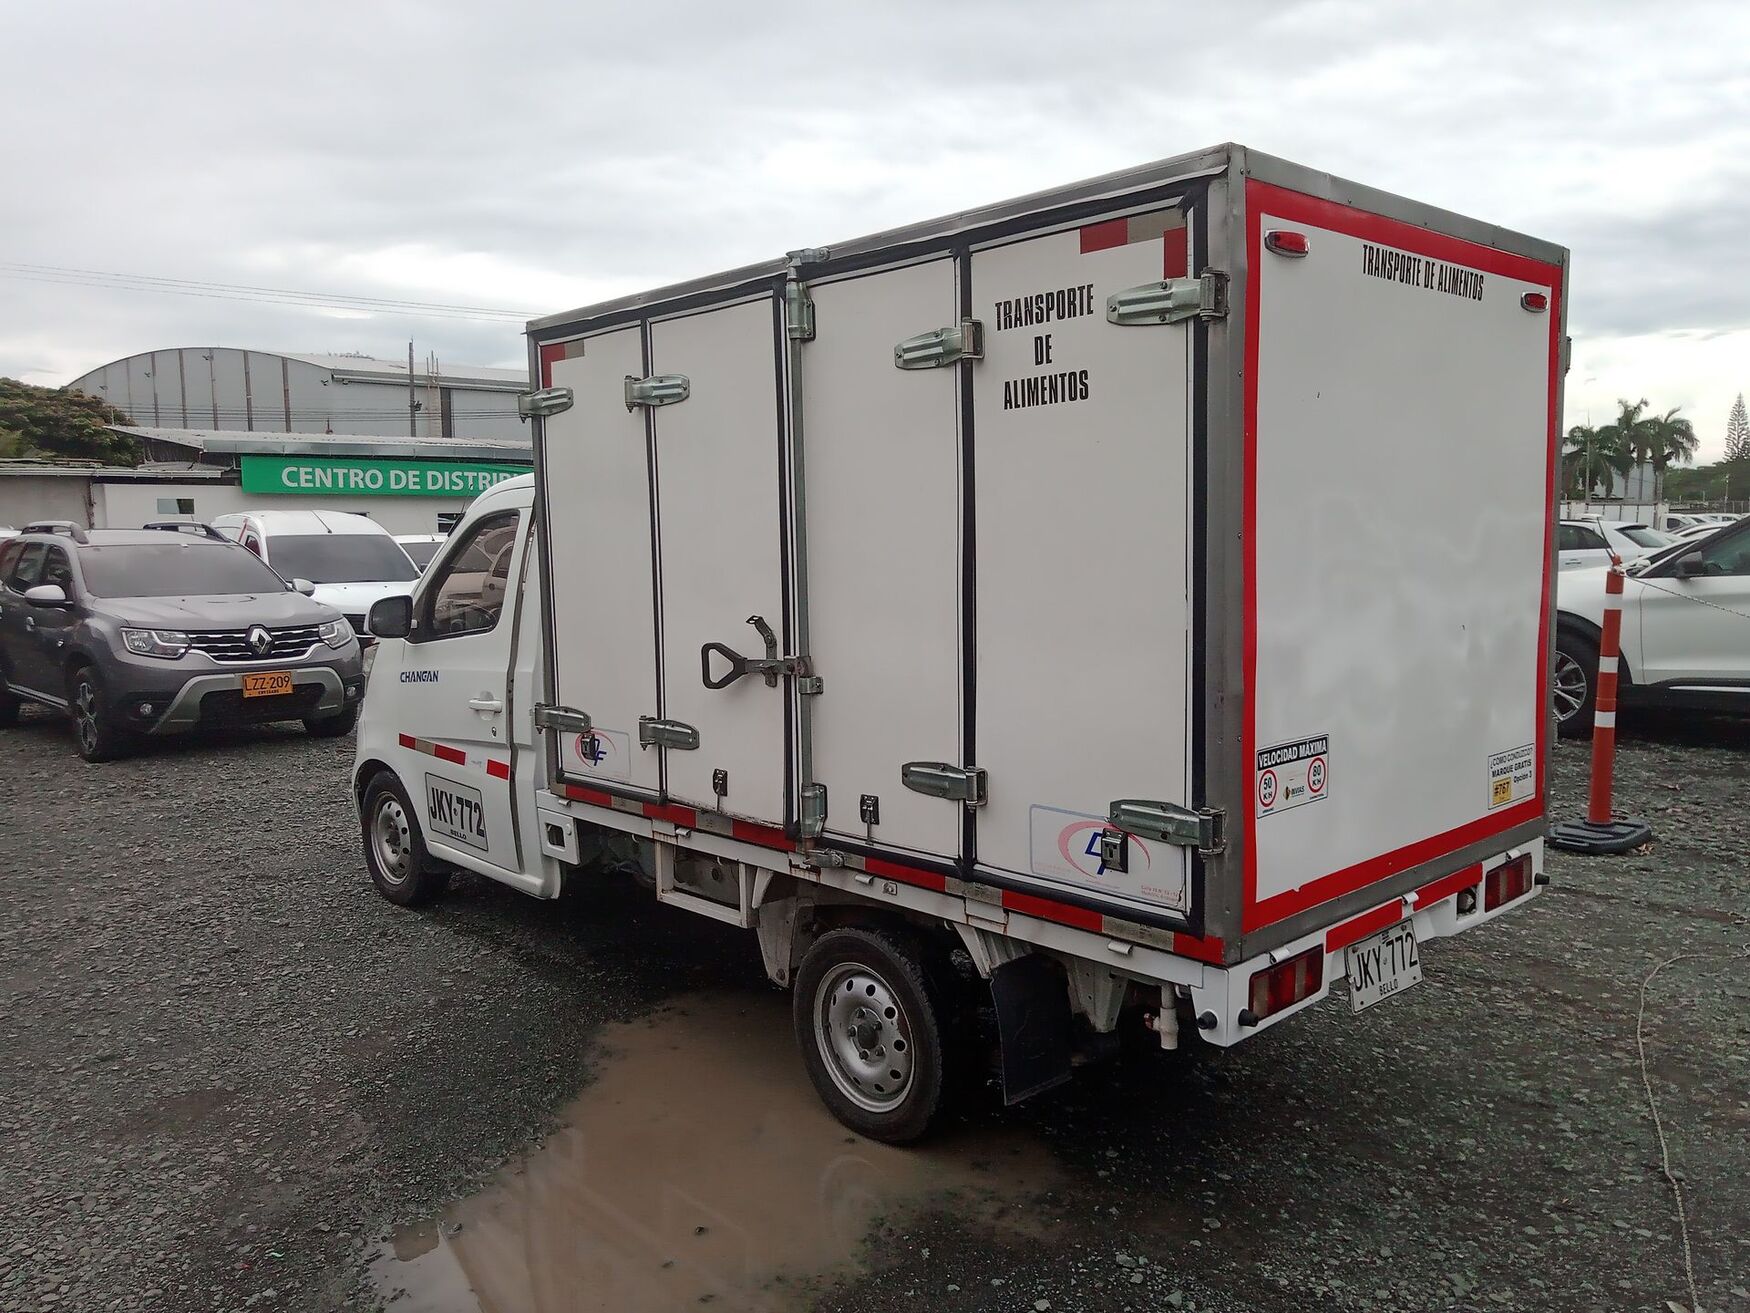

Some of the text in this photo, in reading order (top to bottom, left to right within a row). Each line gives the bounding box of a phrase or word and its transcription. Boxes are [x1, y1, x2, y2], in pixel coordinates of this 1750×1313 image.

[1363, 244, 1484, 301] TRANSPORTE DE ALIMENTOS
[995, 283, 1094, 331] TRANSPORTE
[1034, 334, 1052, 366] DE
[1004, 369, 1089, 410] ALIMENTOS
[281, 466, 519, 491] CENTRO DE DISTRI
[400, 670, 439, 683] CHANGAN
[1258, 746, 1298, 768] VELOCIDAD
[1312, 764, 1322, 777] 80
[1492, 759, 1531, 778] MARQUE GRATIS
[1263, 776, 1273, 790] 50
[450, 829, 467, 840] BELLO
[1380, 978, 1399, 996] BELLO
